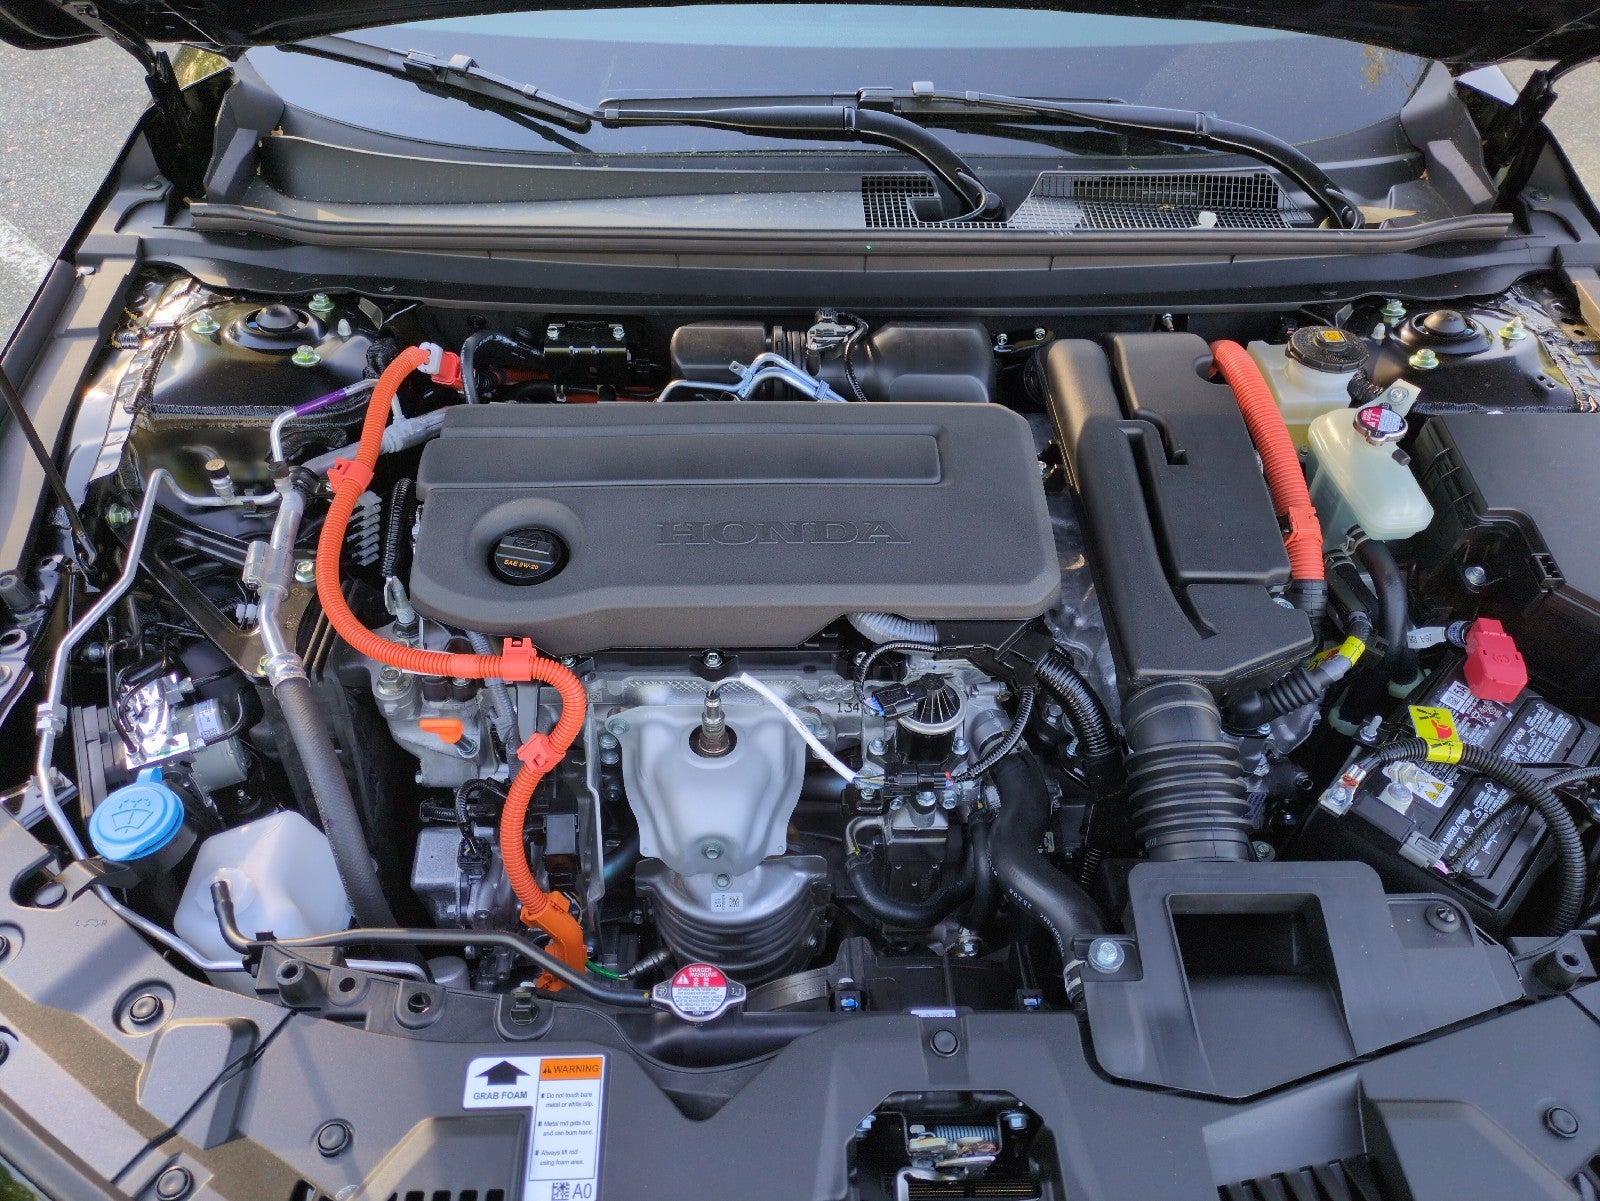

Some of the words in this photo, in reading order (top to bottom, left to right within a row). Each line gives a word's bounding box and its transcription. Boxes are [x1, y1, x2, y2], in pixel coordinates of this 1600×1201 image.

[656, 520, 911, 546] HONDA
[503, 559, 518, 567] SAE
[1453, 683, 1469, 697] 5A
[837, 702, 860, 713] 134
[553, 1065, 600, 1074] WARNING
[473, 1092, 499, 1100] GRAB
[501, 1091, 528, 1099] FOAM
[572, 1183, 593, 1199] A0
